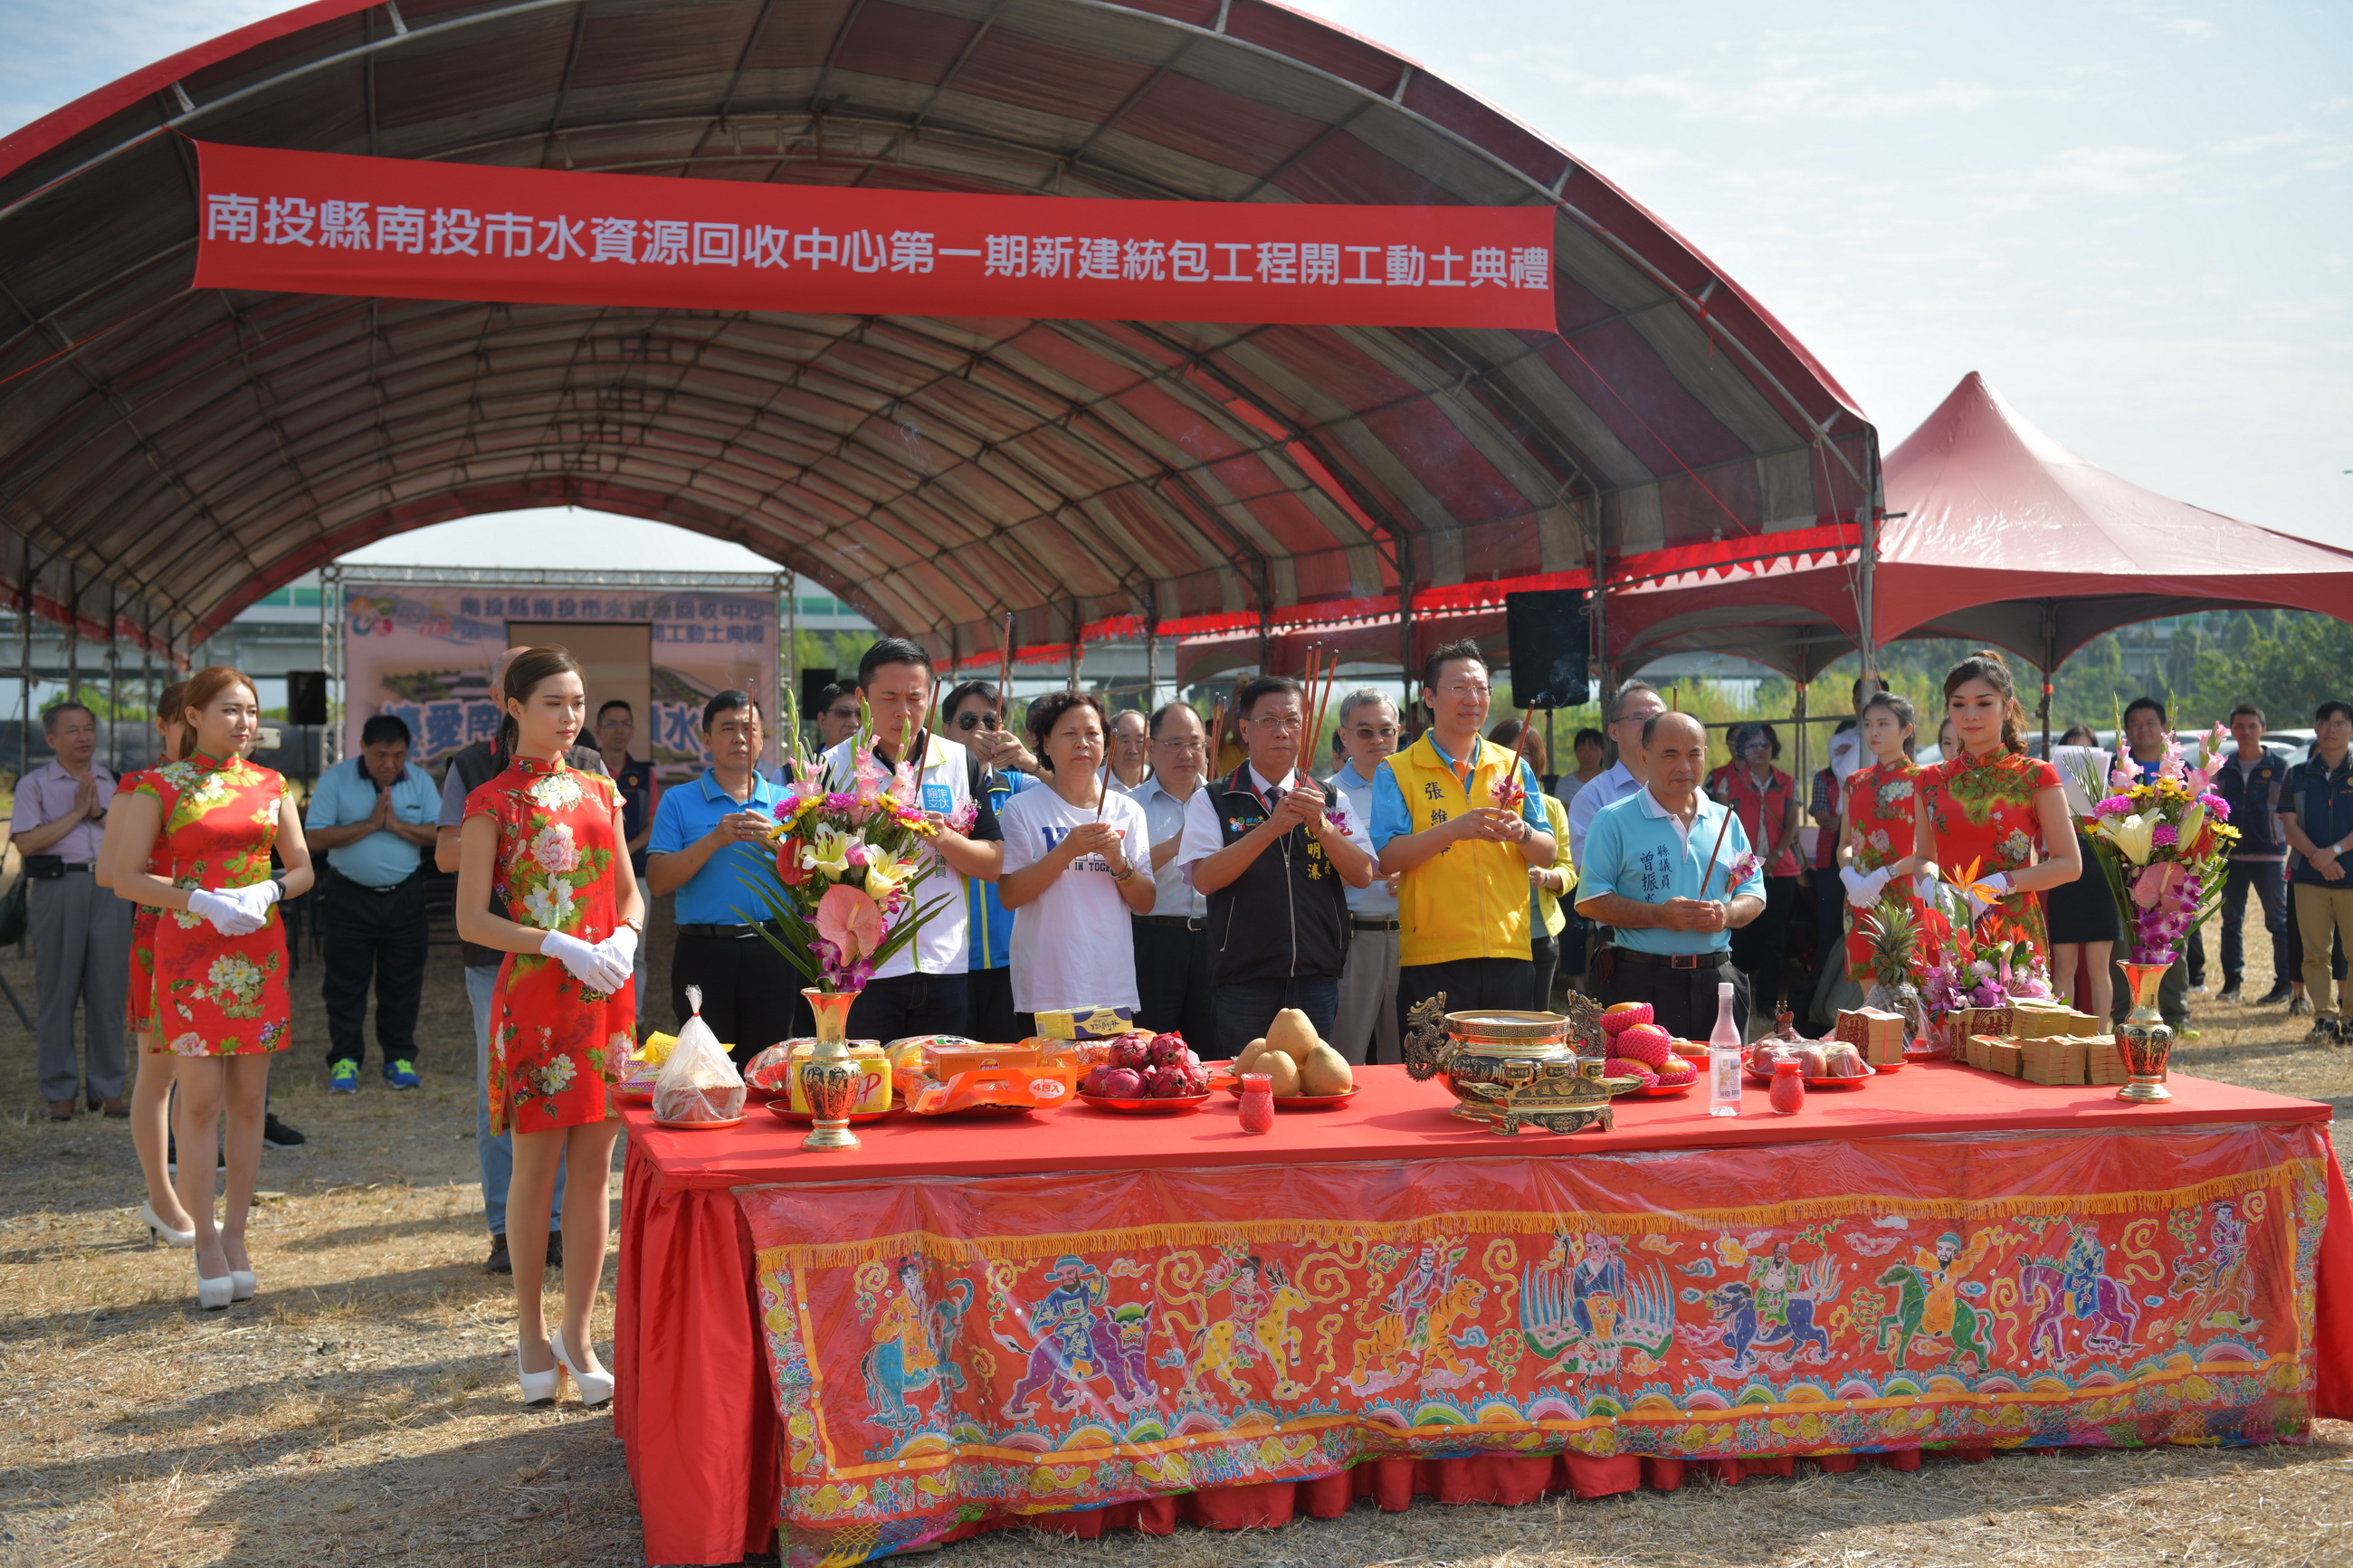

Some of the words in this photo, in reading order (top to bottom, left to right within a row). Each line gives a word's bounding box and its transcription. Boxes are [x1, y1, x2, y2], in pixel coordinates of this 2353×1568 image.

[205, 192, 1550, 290] 南投縣南投市水資源回收中心第一期新建統包工程開工動土典禮
[1075, 861, 1083, 870] IN
[1657, 844, 1672, 889] 縣議員
[1033, 1083, 1060, 1093] 4包入
